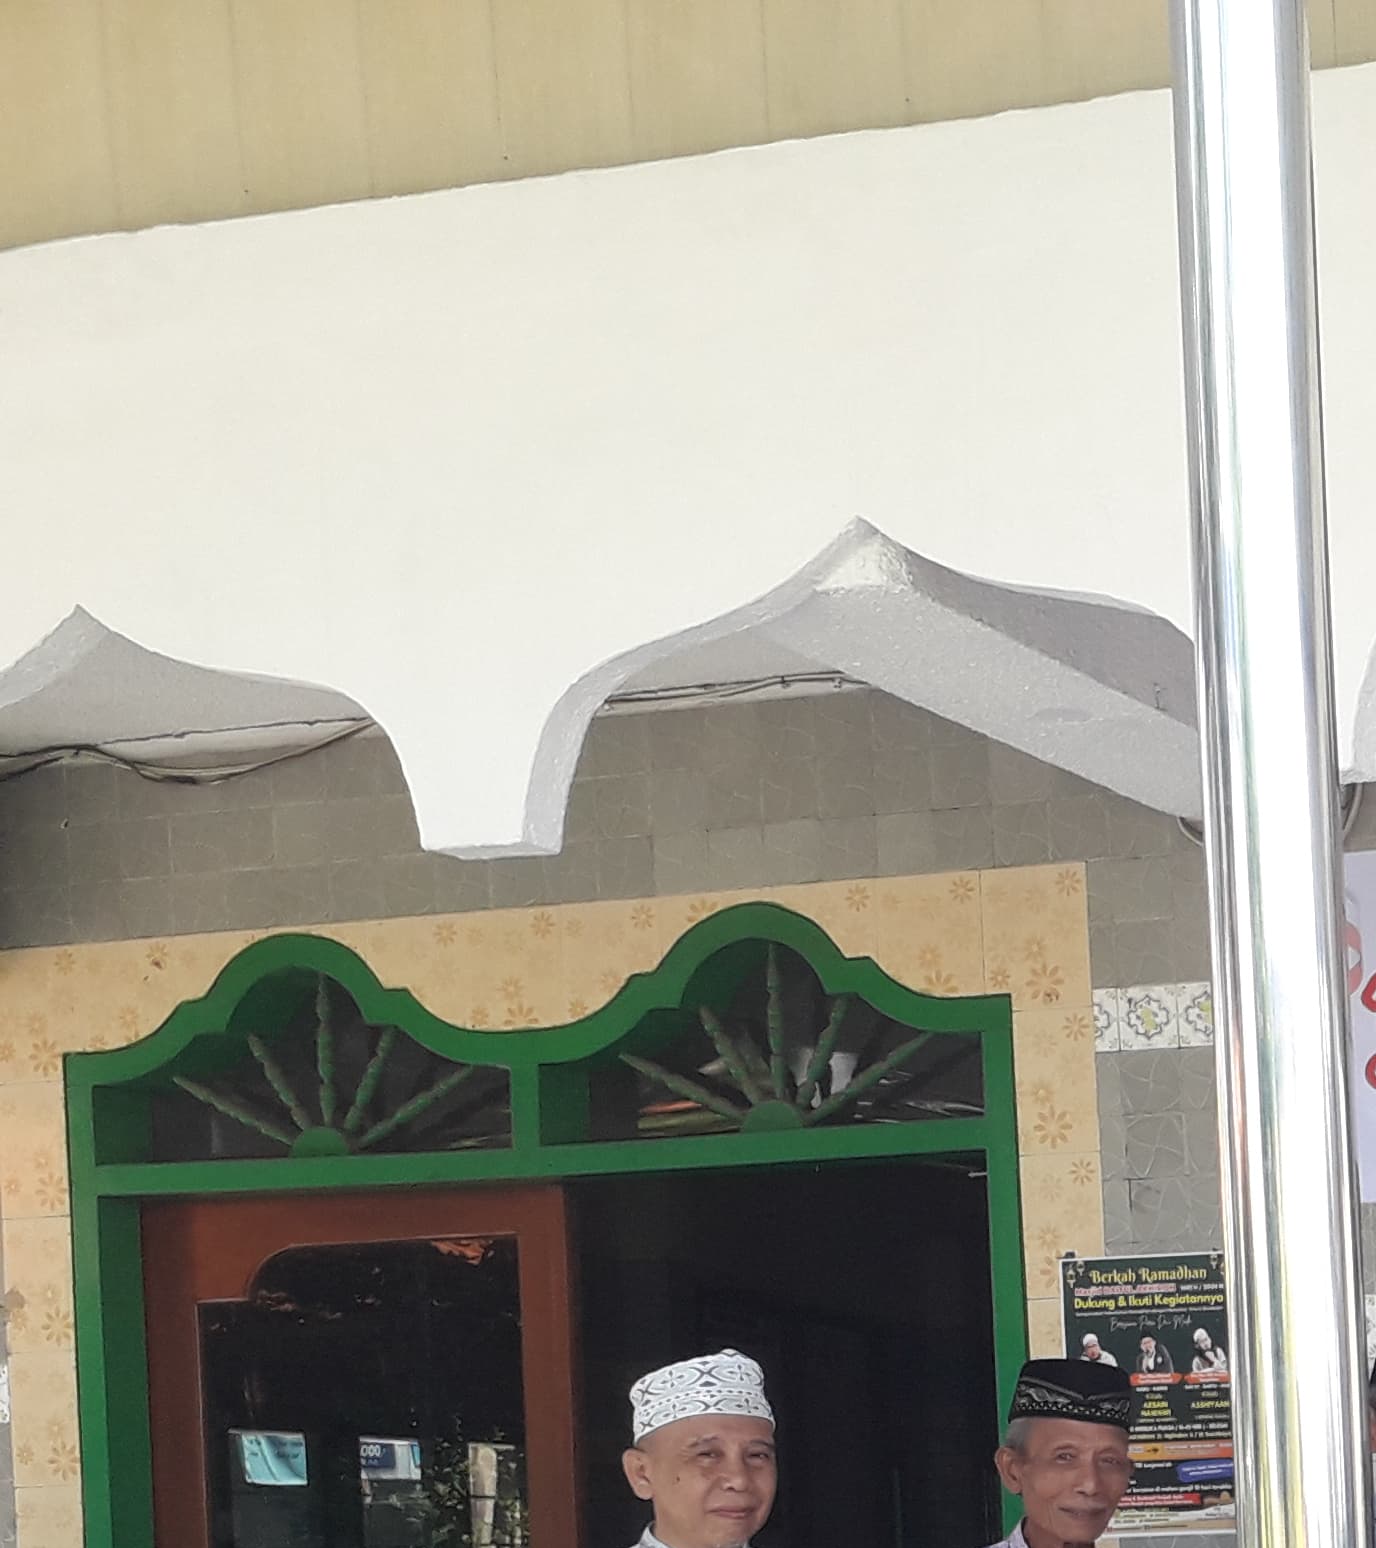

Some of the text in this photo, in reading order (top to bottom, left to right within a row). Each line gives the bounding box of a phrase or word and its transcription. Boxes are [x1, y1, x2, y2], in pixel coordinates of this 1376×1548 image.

[1089, 1265, 1207, 1284] Berkah Ramadhan
[1074, 1292, 1224, 1309] Dukung & Ikuti Kegiatannya
